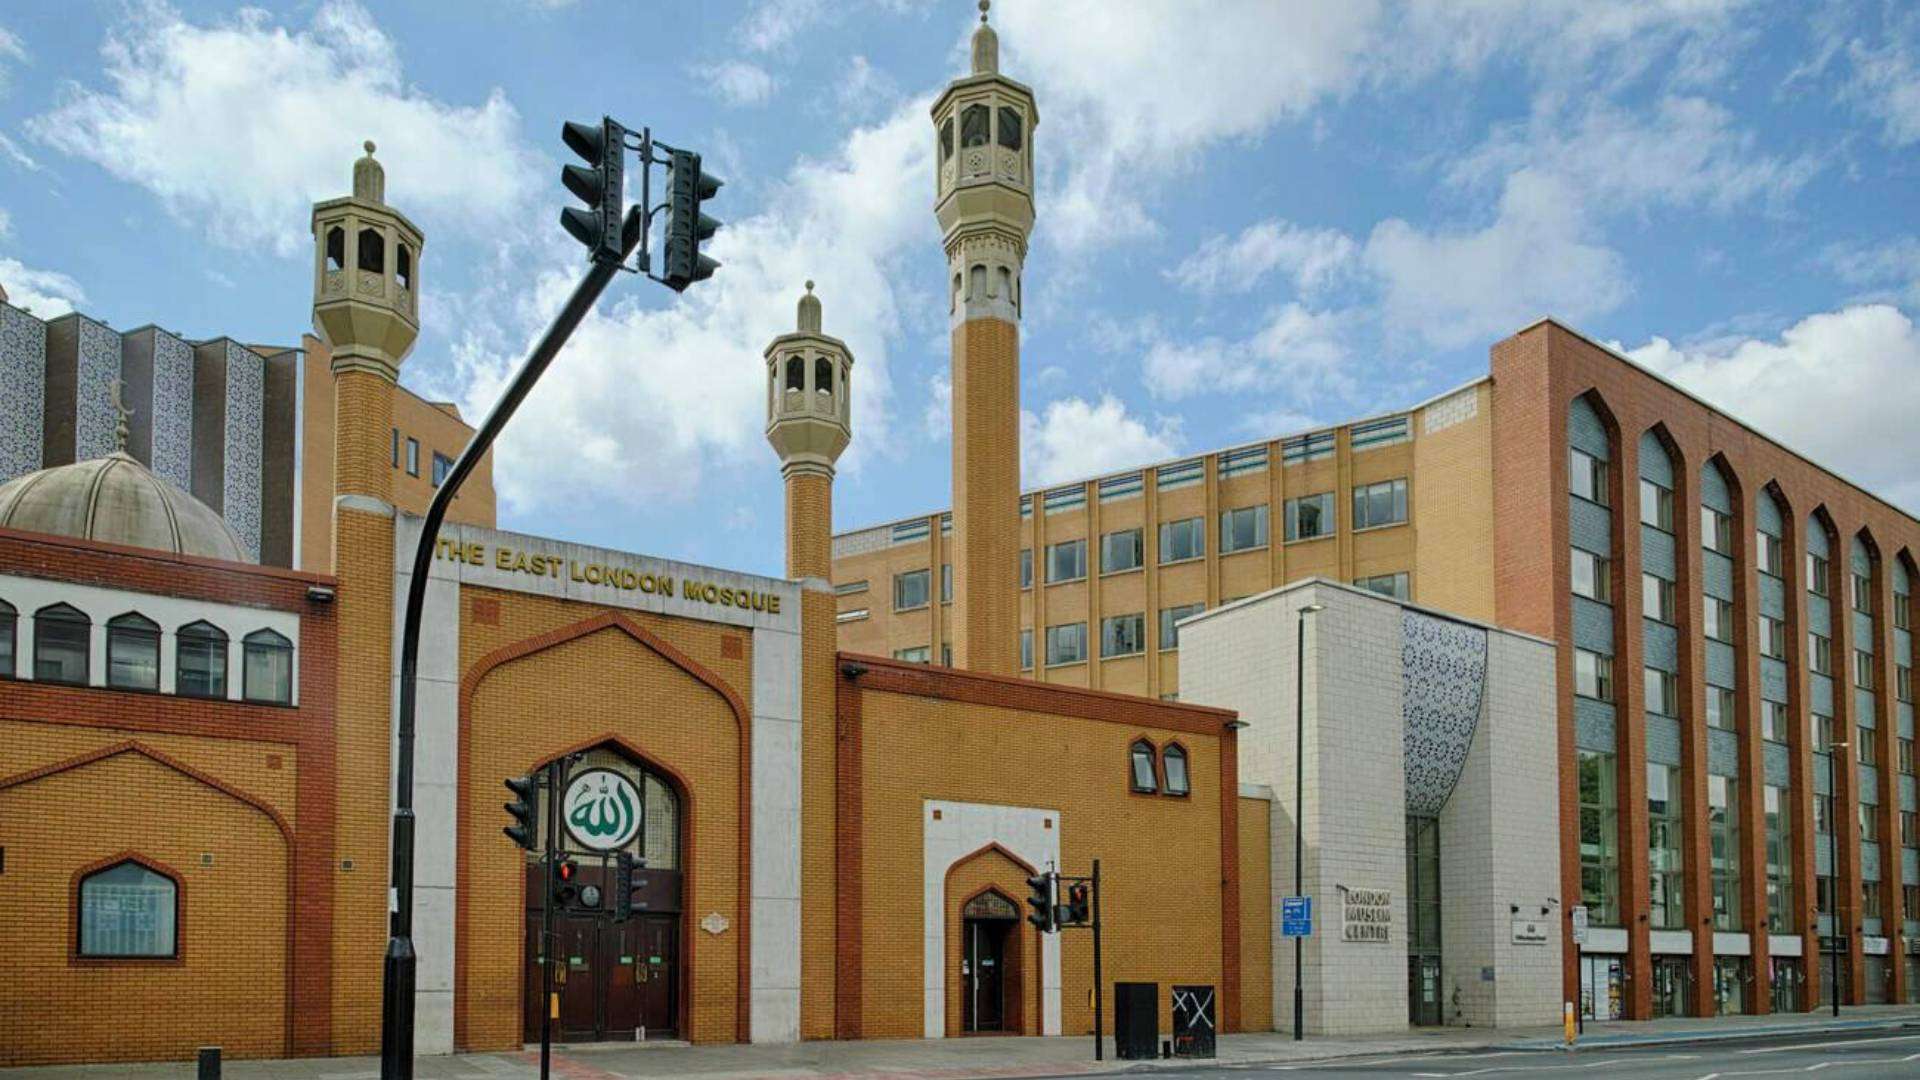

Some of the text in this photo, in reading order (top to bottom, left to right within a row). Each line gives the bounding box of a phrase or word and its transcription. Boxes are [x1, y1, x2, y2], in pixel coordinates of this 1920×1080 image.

[435, 537, 781, 614] THE EAST LONDON MOSQUE
